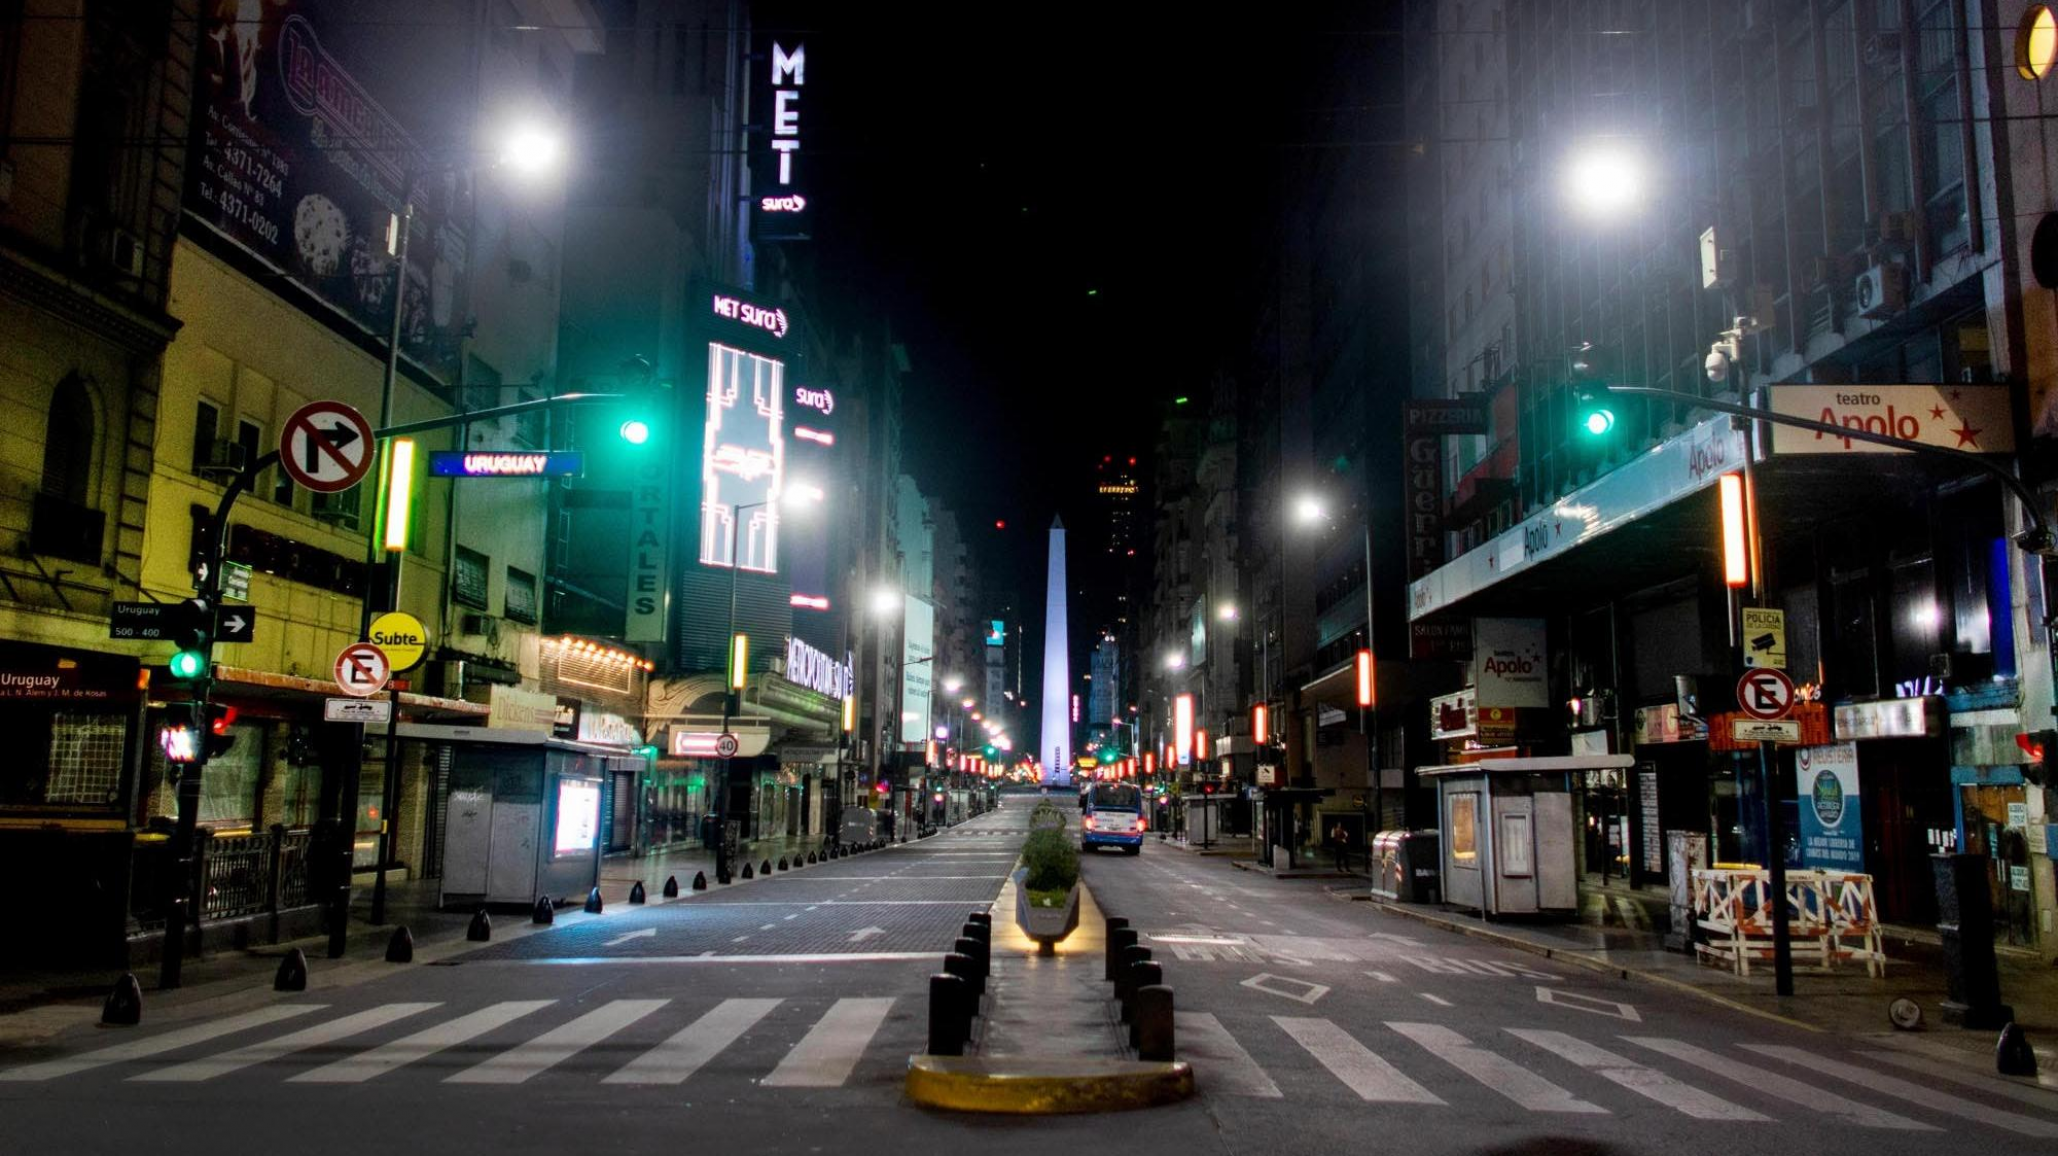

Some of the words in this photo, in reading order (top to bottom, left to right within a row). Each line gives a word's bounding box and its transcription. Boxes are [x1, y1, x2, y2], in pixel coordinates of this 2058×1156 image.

[771, 40, 805, 184] MET
[224, 143, 282, 198] 4371-7264
[762, 197, 796, 211] sura
[219, 190, 279, 245] 4371-0202
[714, 295, 740, 318] MET
[741, 303, 776, 331] sura
[796, 387, 825, 409] sura
[1836, 393, 1880, 405] teatro
[1409, 408, 1483, 426] PIZZERIA
[1815, 405, 1919, 449] Apolo
[465, 455, 547, 473] URUGUAY
[1689, 431, 1724, 480] Apolo
[1524, 520, 1548, 562] Apolo
[117, 605, 160, 616] Uruguay
[115, 627, 133, 636] 500
[142, 628, 159, 637] 400
[374, 632, 417, 645] Subte
[1484, 657, 1533, 678] Apolo
[1, 673, 60, 689] Uruguay
[719, 741, 734, 751] 40
